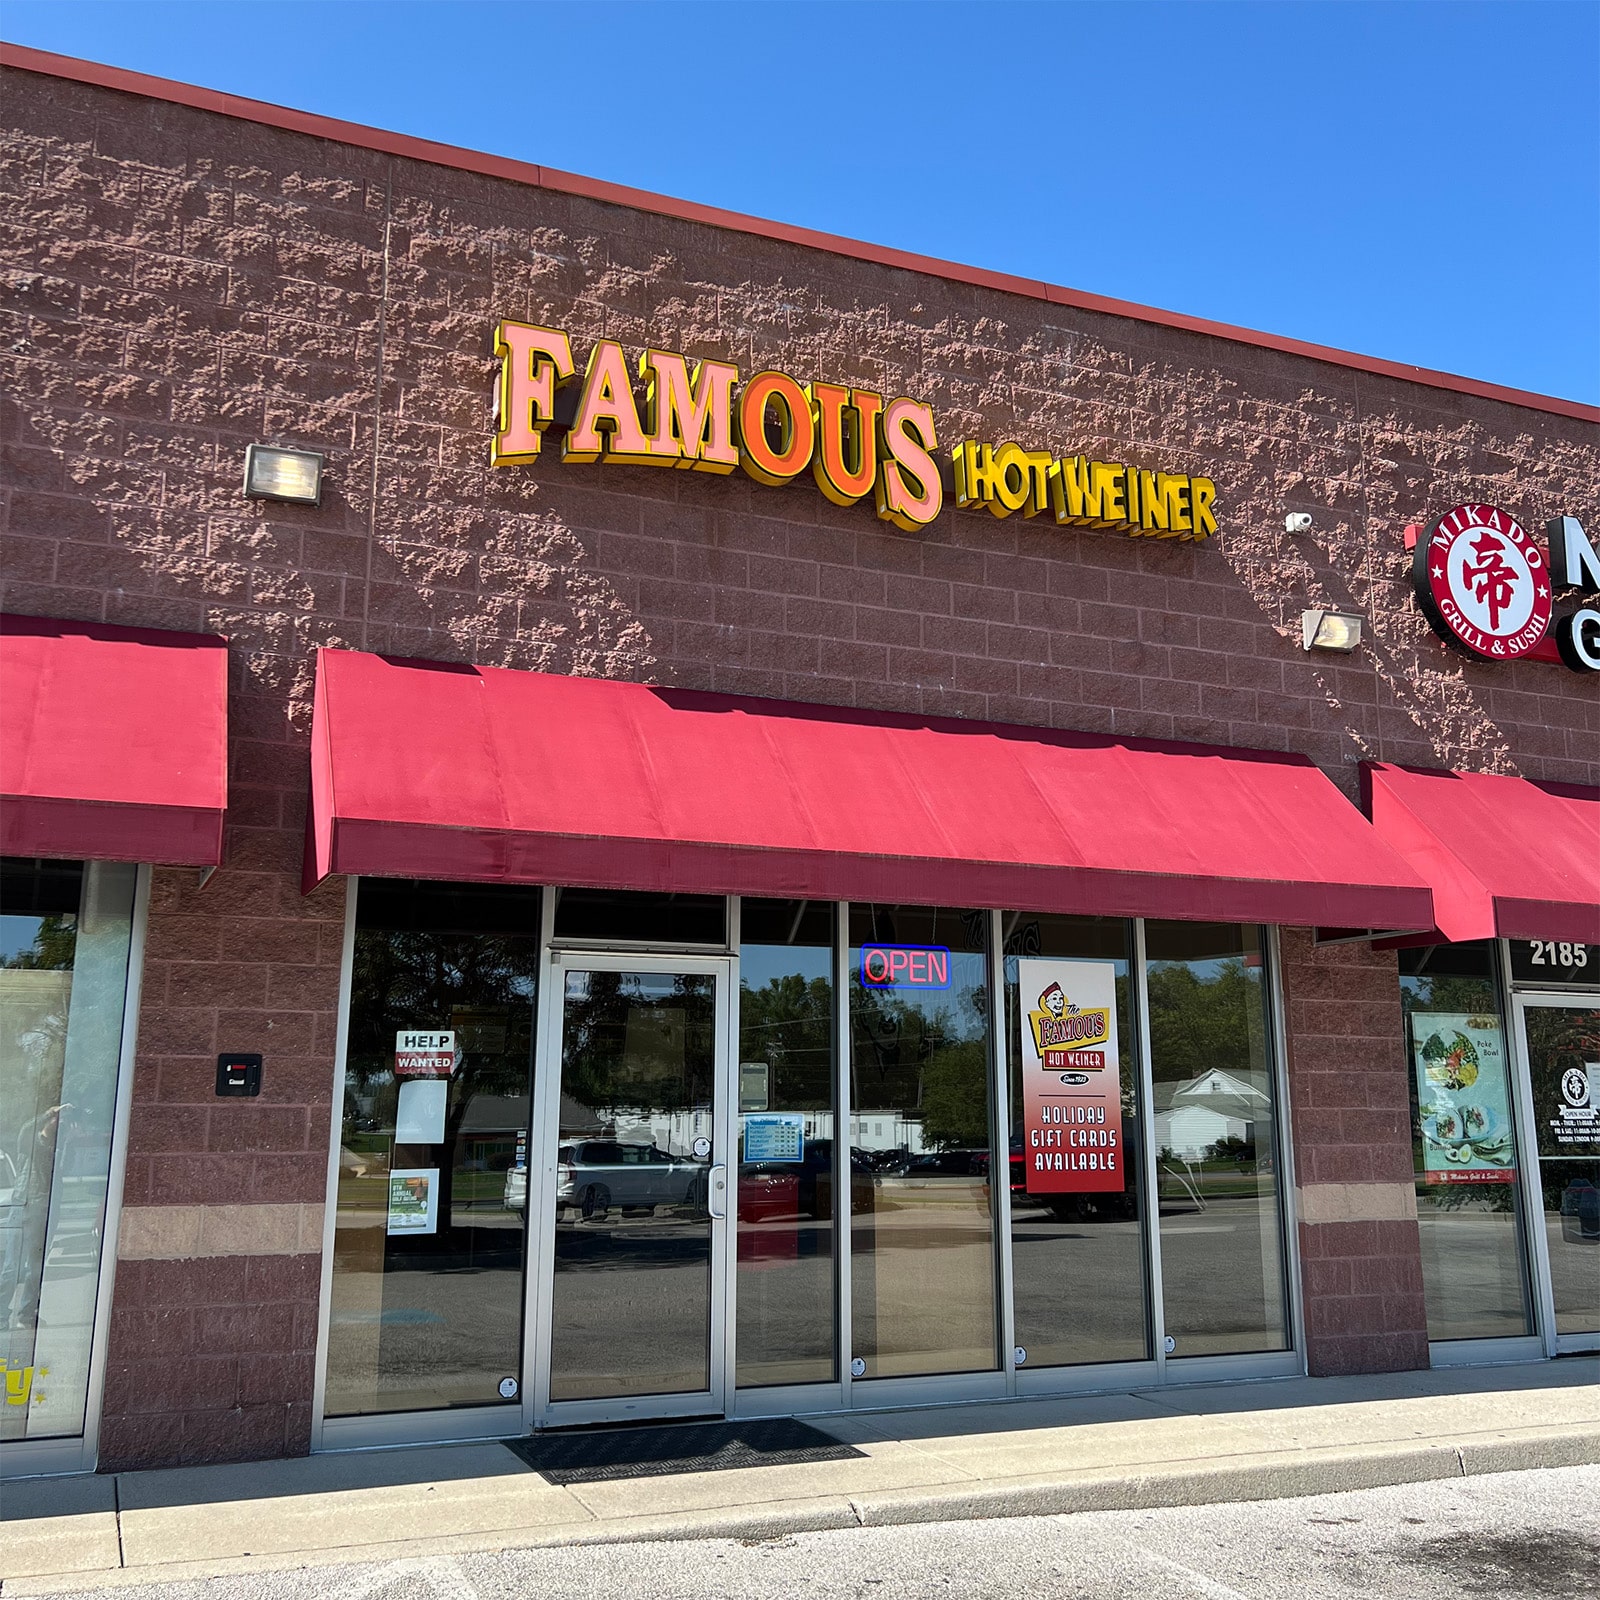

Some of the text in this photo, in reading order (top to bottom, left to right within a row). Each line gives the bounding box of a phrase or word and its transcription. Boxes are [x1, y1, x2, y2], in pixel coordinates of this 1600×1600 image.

[490, 320, 1218, 541] FAMOUS HOT WEINER
[1432, 504, 1543, 569] MIKADO
[1440, 598, 1546, 655] GRILL & SUSHI
[1529, 940, 1588, 967] 2185
[864, 950, 948, 983] OPEN
[1065, 1002, 1080, 1015] The
[1039, 1012, 1105, 1048] FAMOUS
[404, 1035, 450, 1048] HELP
[398, 1057, 451, 1068] WANTED
[1048, 1052, 1101, 1067] HOT WEINER
[1041, 1106, 1106, 1124] HOLIDAY
[1031, 1129, 1117, 1148] GIFT CARDS
[1035, 1152, 1115, 1171] AVAILABLE
